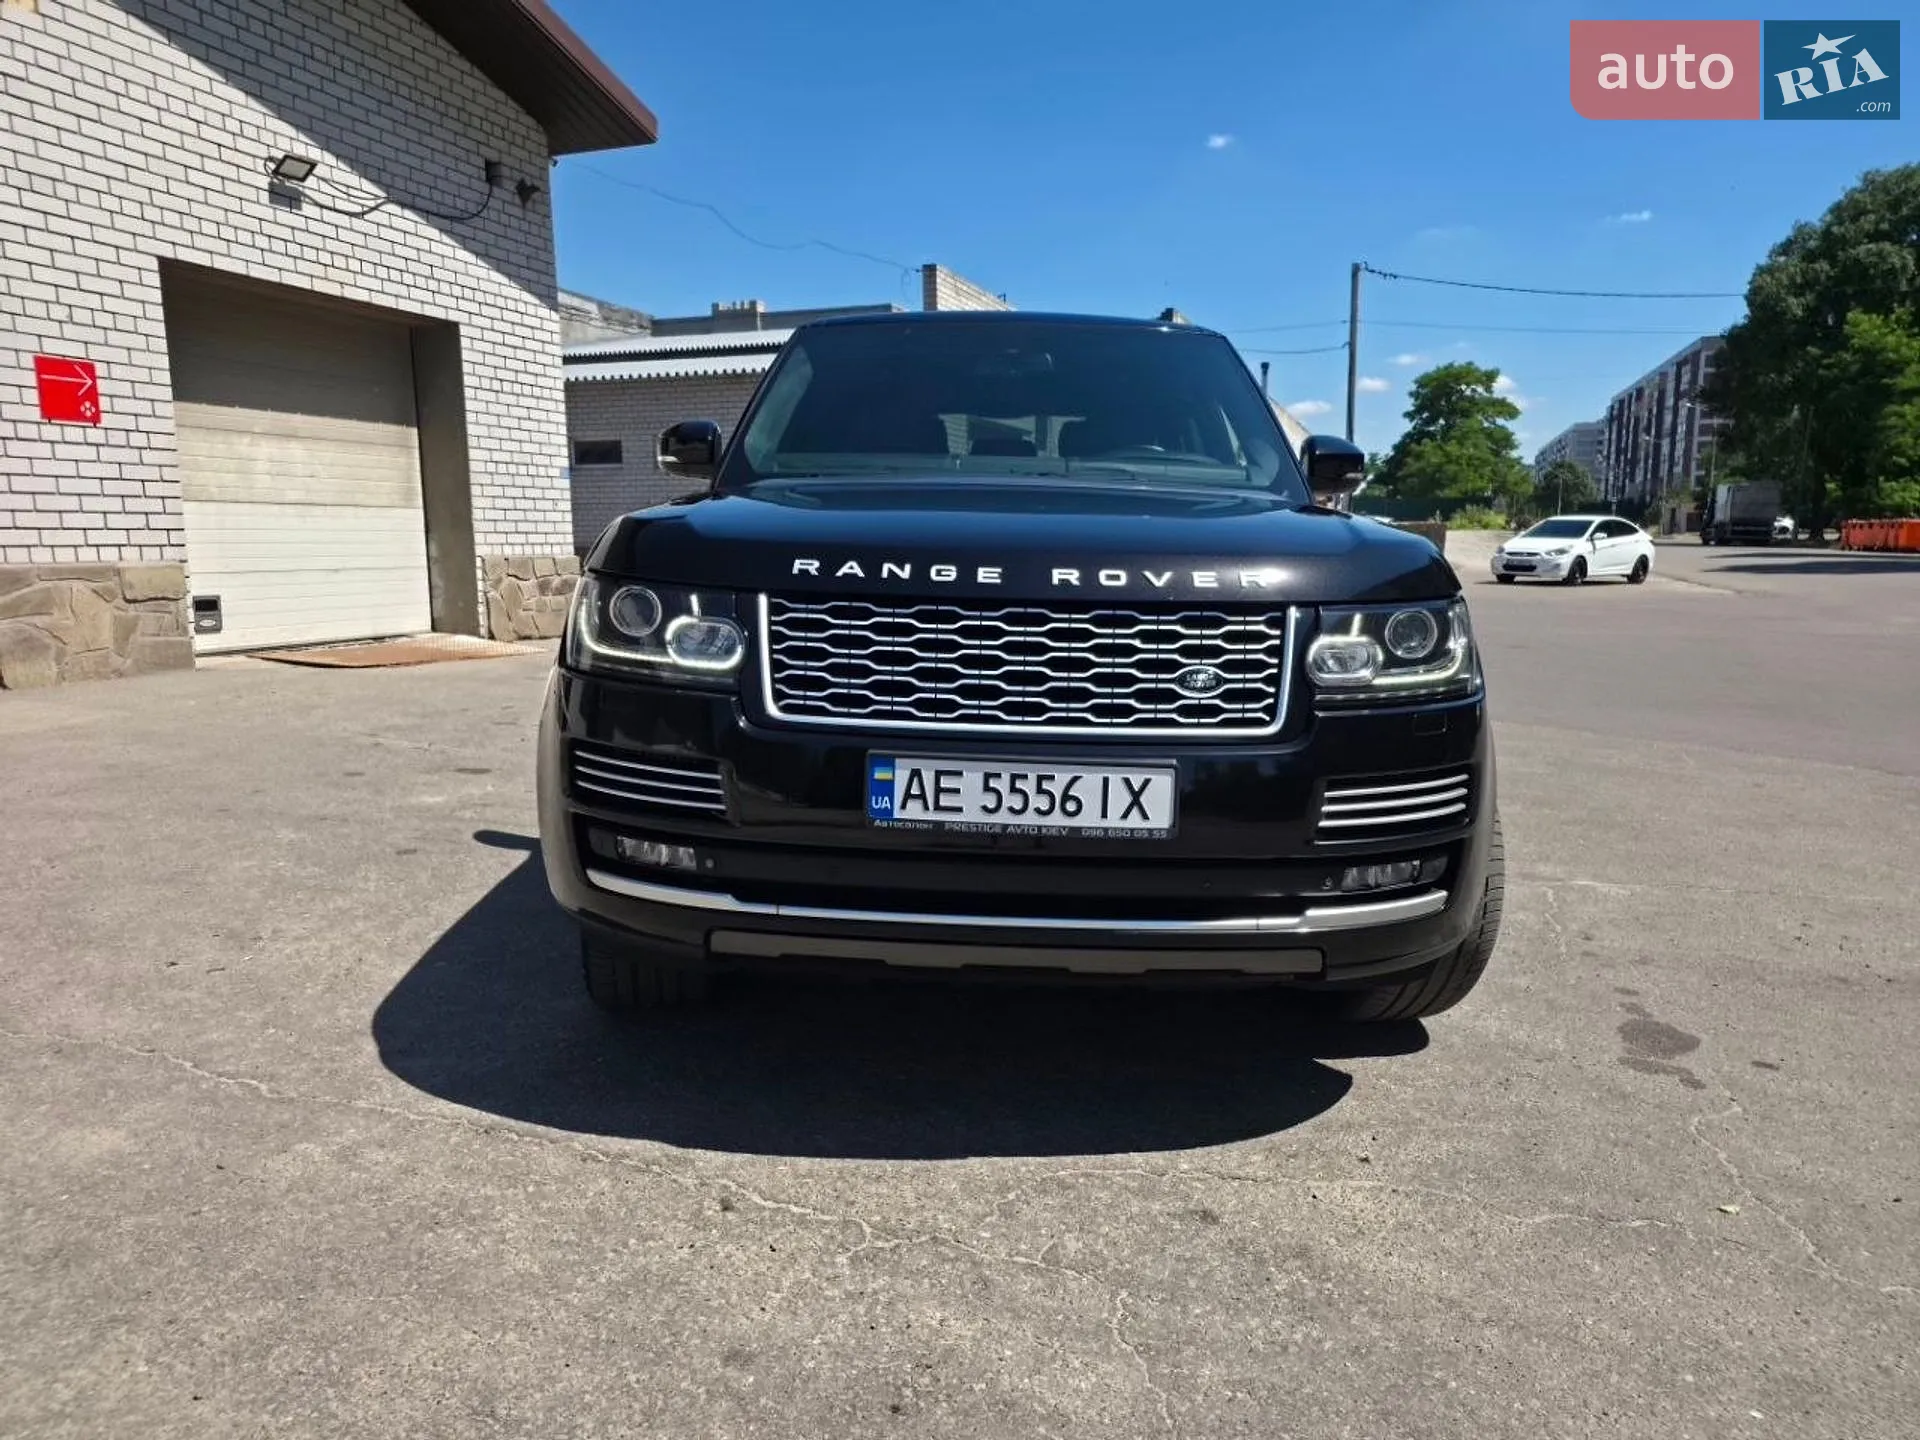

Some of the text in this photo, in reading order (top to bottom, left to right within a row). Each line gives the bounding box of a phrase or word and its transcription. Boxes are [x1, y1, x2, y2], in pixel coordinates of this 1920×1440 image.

[792, 559, 1268, 588] RANGE ROVER
[871, 796, 891, 810] UA
[900, 767, 1152, 821] AE 5556 IX
[944, 822, 1002, 834] PRESTIGE
[1006, 825, 1038, 836] AVTO
[1041, 827, 1069, 837] KIEV
